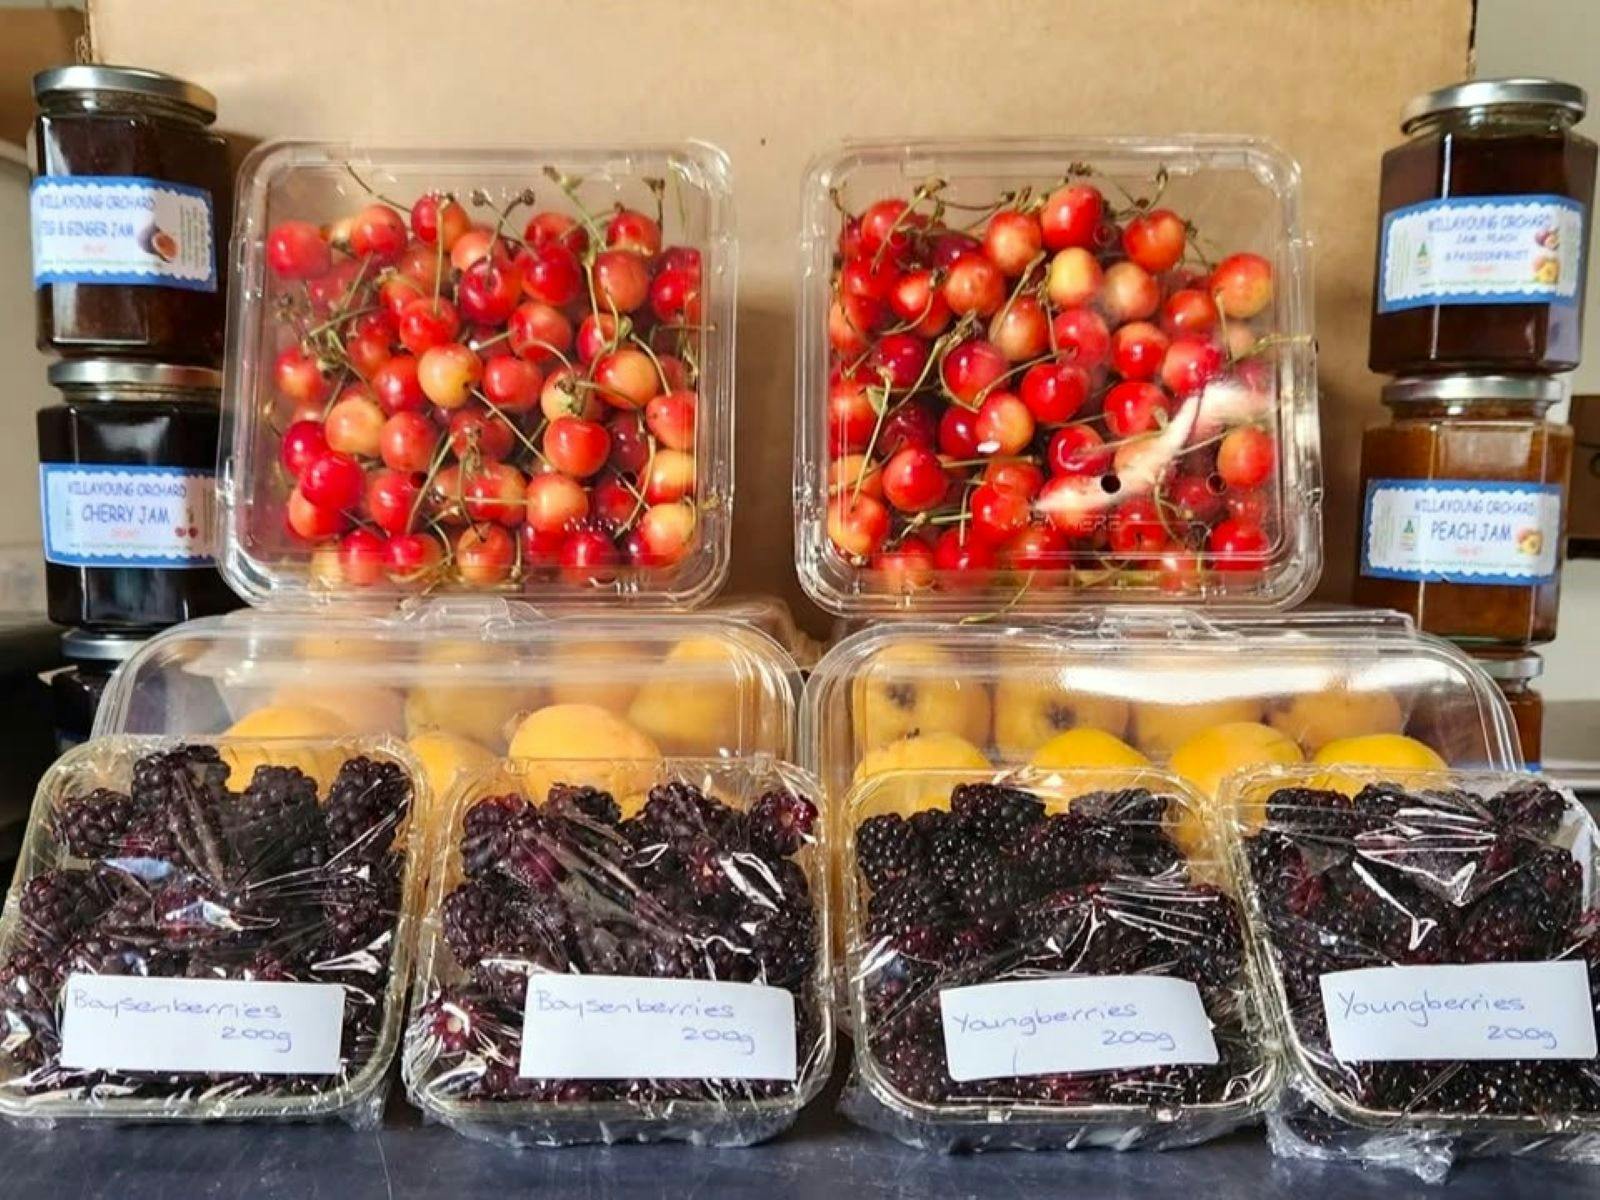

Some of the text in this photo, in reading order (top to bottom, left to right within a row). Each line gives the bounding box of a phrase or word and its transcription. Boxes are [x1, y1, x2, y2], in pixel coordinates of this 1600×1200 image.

[106, 194, 157, 212] ORCHARD
[111, 221, 135, 239] JAM
[137, 482, 188, 499] ORCHARD
[82, 502, 171, 525] CHERRY JAM
[1486, 499, 1536, 516] ORCHARD
[1431, 519, 1513, 543] PEACH JAM
[73, 988, 283, 1019] Boysenberries
[536, 989, 737, 1020] Boysenberries
[1336, 989, 1527, 1028] Youngberries
[953, 1001, 1140, 1036] Youngberries
[220, 1024, 293, 1055] 200g
[681, 1026, 756, 1056] 200g
[1101, 1029, 1177, 1051] 200g
[1486, 1025, 1558, 1051] 200g
